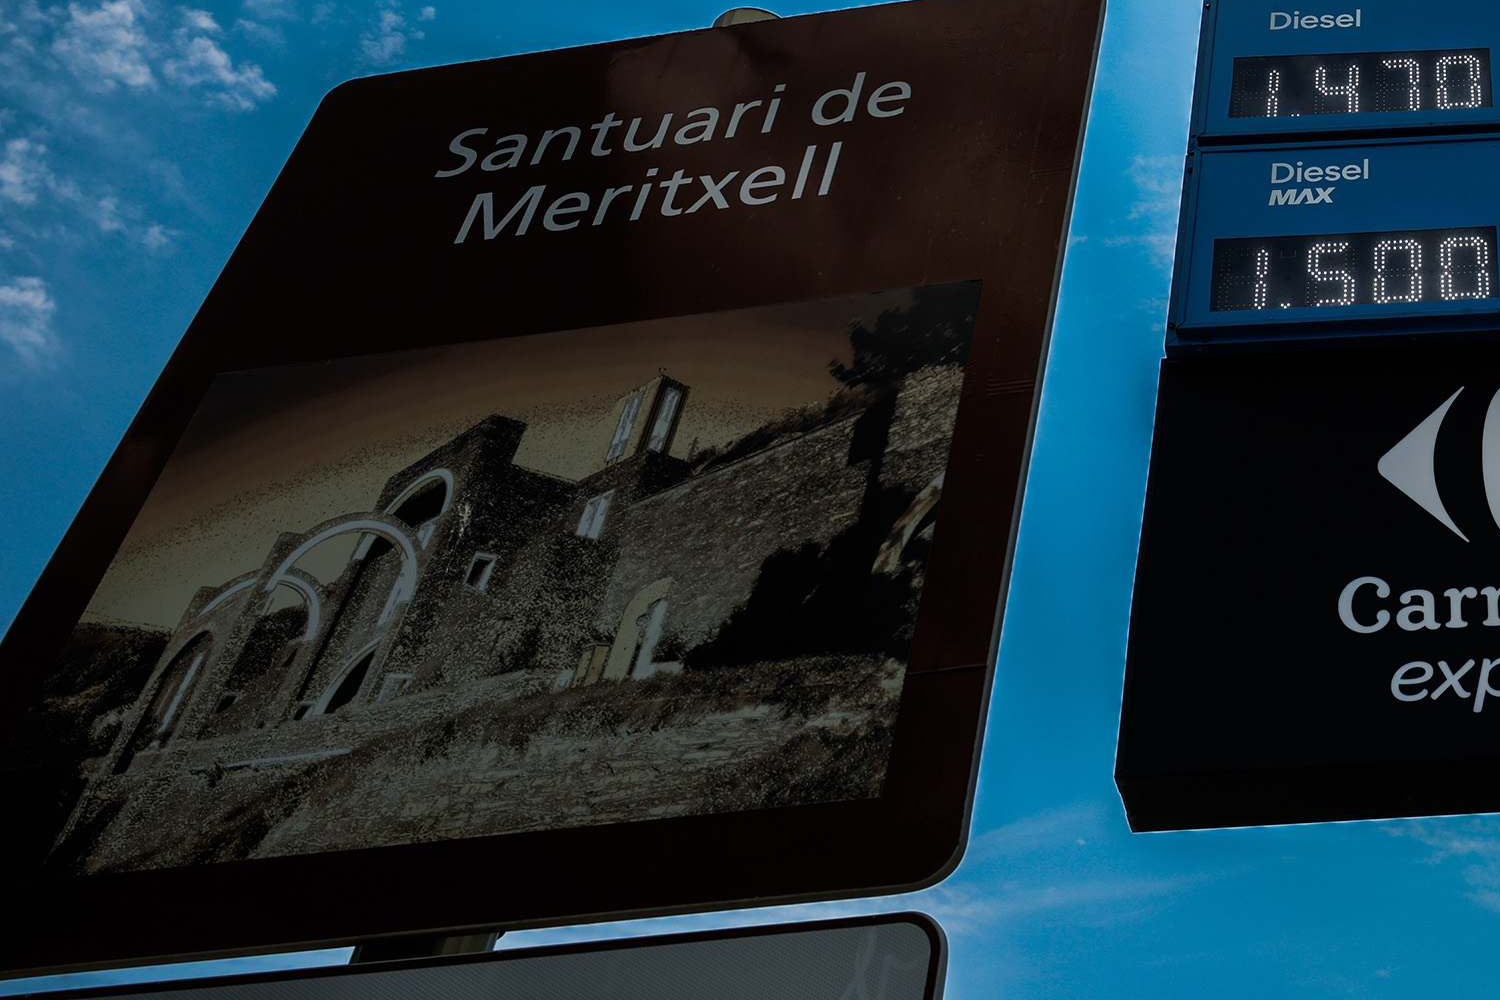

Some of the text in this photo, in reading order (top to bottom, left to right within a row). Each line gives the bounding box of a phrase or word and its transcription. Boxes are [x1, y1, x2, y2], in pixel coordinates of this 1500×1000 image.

[1269, 9, 1361, 30] Diesel
[434, 72, 912, 179] Santuari de
[453, 141, 844, 245] Meritxell
[1268, 186, 1334, 206] MAX
[1270, 159, 1369, 184] Diesel
[1253, 236, 1490, 310] 1.500
